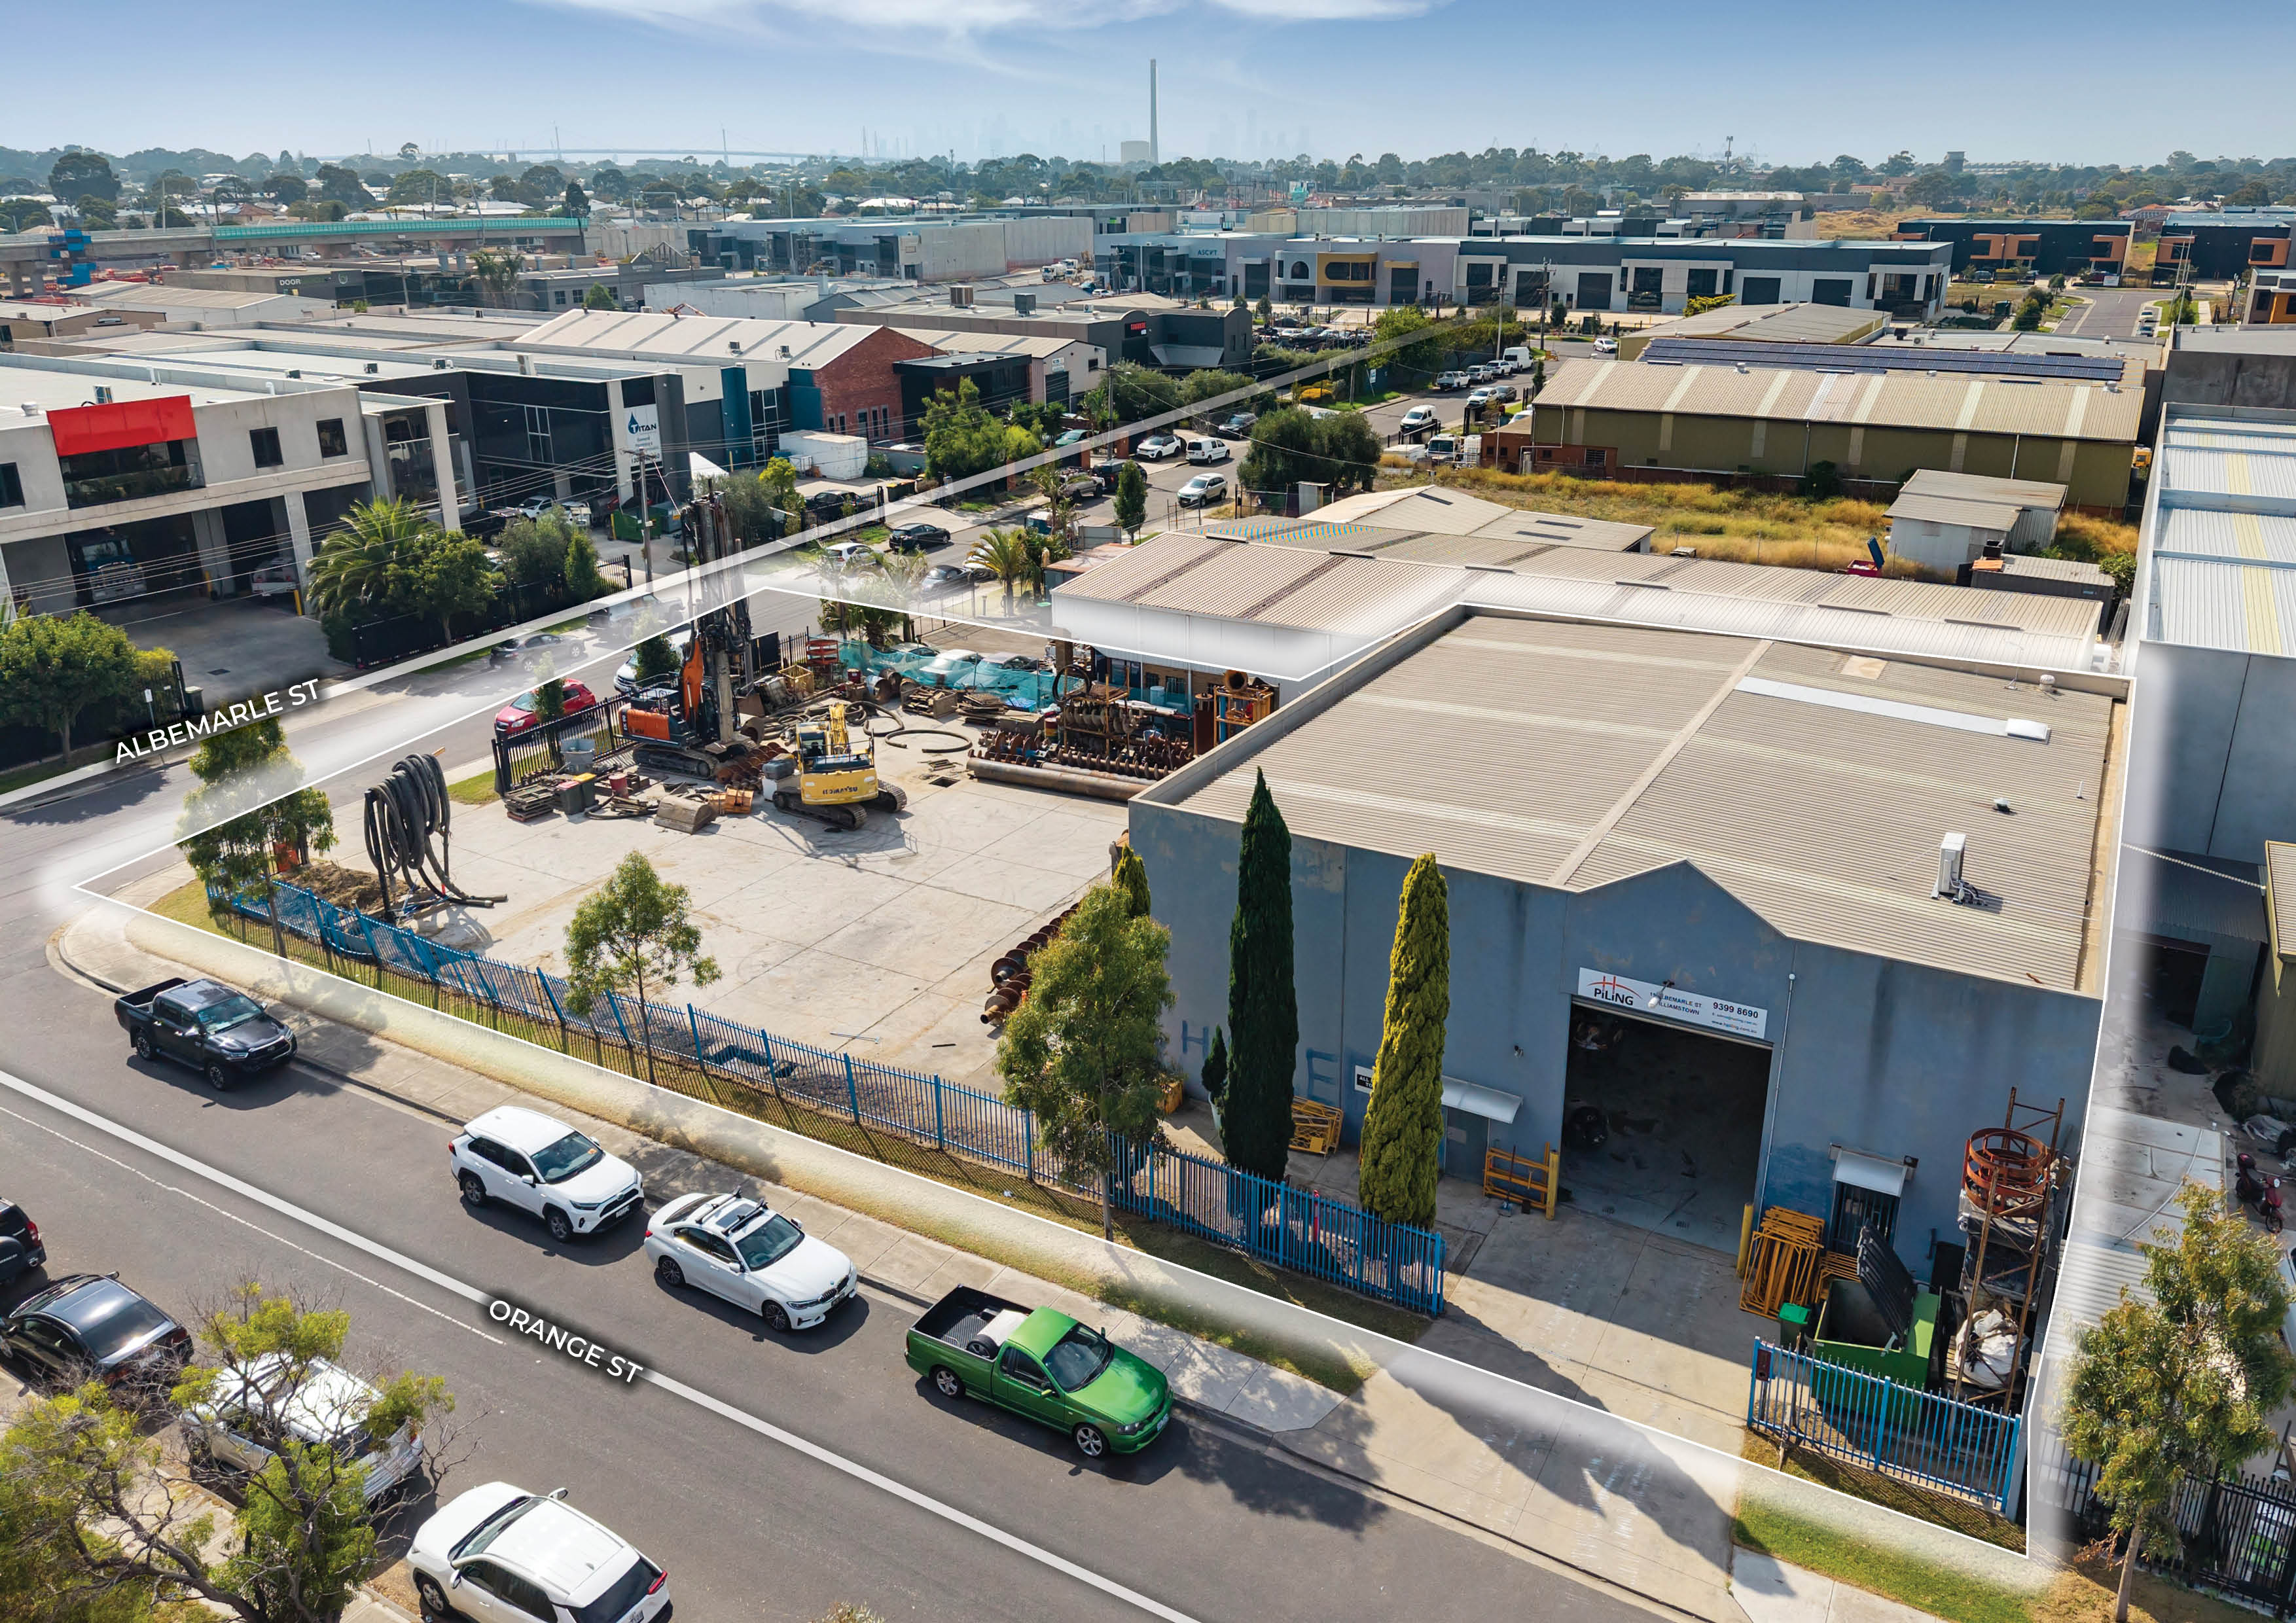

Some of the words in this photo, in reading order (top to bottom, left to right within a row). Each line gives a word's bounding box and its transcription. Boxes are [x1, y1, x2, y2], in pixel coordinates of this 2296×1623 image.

[630, 423, 656, 433] TITAN
[1659, 1001, 1700, 1015] ILLIAMSTOWN
[1713, 1002, 1734, 1013] 9399
[1736, 1007, 1759, 1018] 8690
